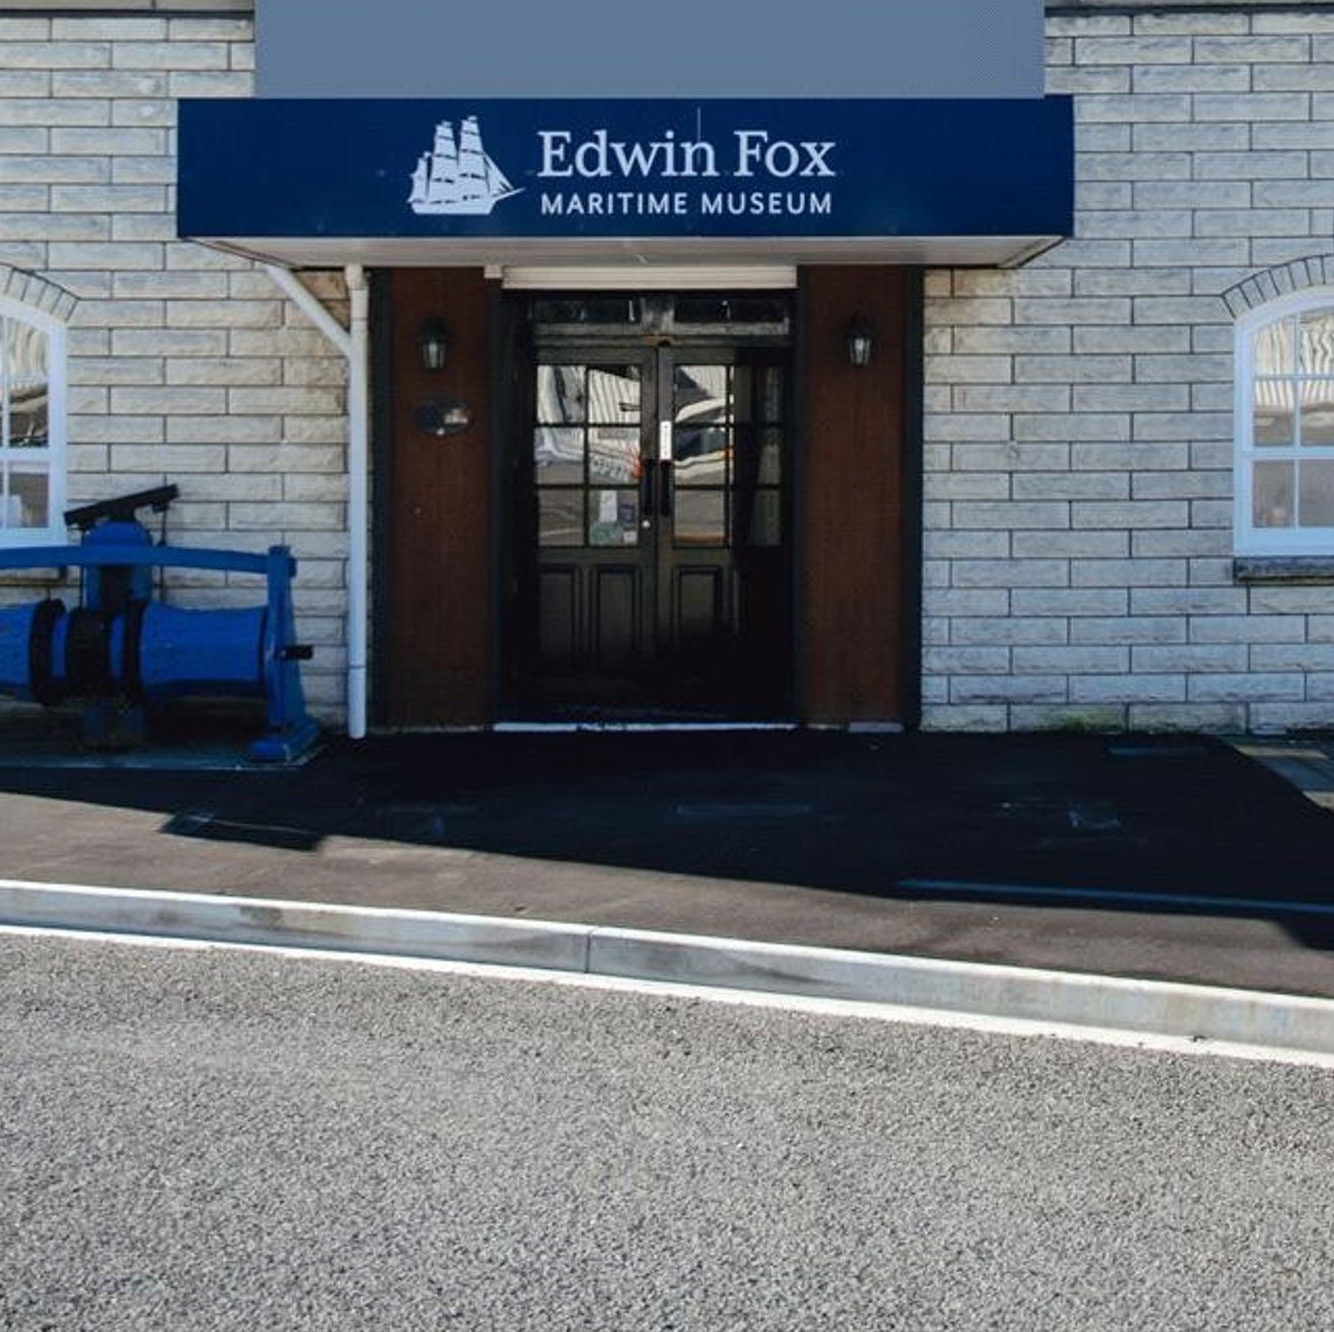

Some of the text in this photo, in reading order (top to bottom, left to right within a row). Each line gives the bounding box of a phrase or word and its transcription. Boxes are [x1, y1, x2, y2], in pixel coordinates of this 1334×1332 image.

[537, 130, 835, 177] Edwin Fox
[541, 192, 832, 214] MARITIME MUSEUM
